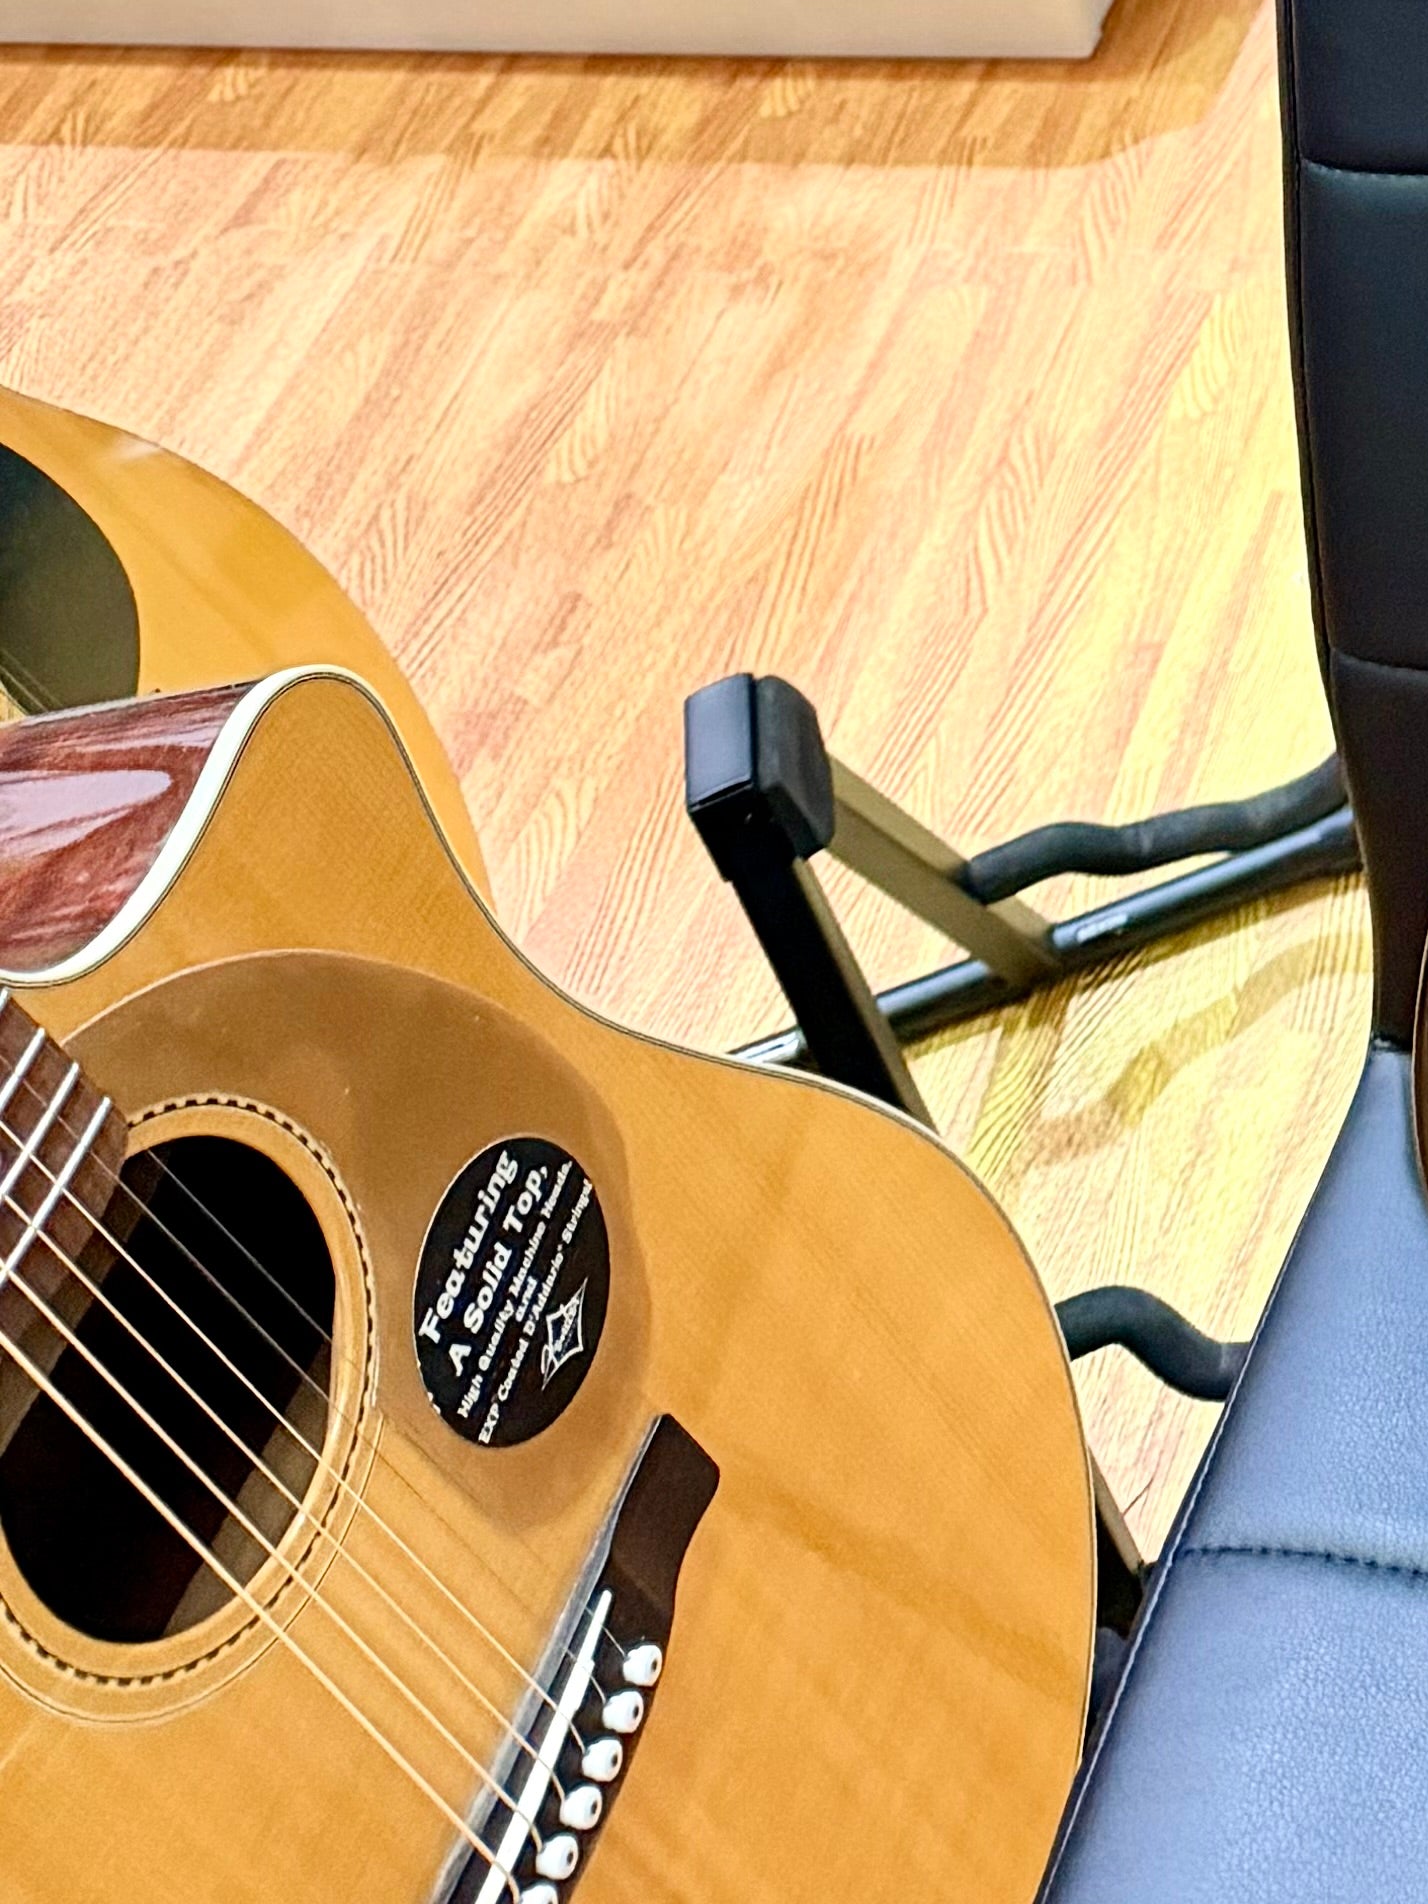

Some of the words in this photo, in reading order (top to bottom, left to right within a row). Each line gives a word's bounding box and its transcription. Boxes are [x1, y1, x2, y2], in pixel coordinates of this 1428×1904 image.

[419, 1149, 518, 1344] Featuring
[448, 1342, 472, 1377] A
[463, 1240, 513, 1335] Solid
[502, 1164, 549, 1233] Top,
[457, 1374, 483, 1419] High
[477, 1297, 515, 1373] Quality
[507, 1220, 547, 1298] Machine
[514, 1275, 539, 1323] and
[478, 1402, 501, 1445] EXP
[496, 1337, 530, 1402] Coated
